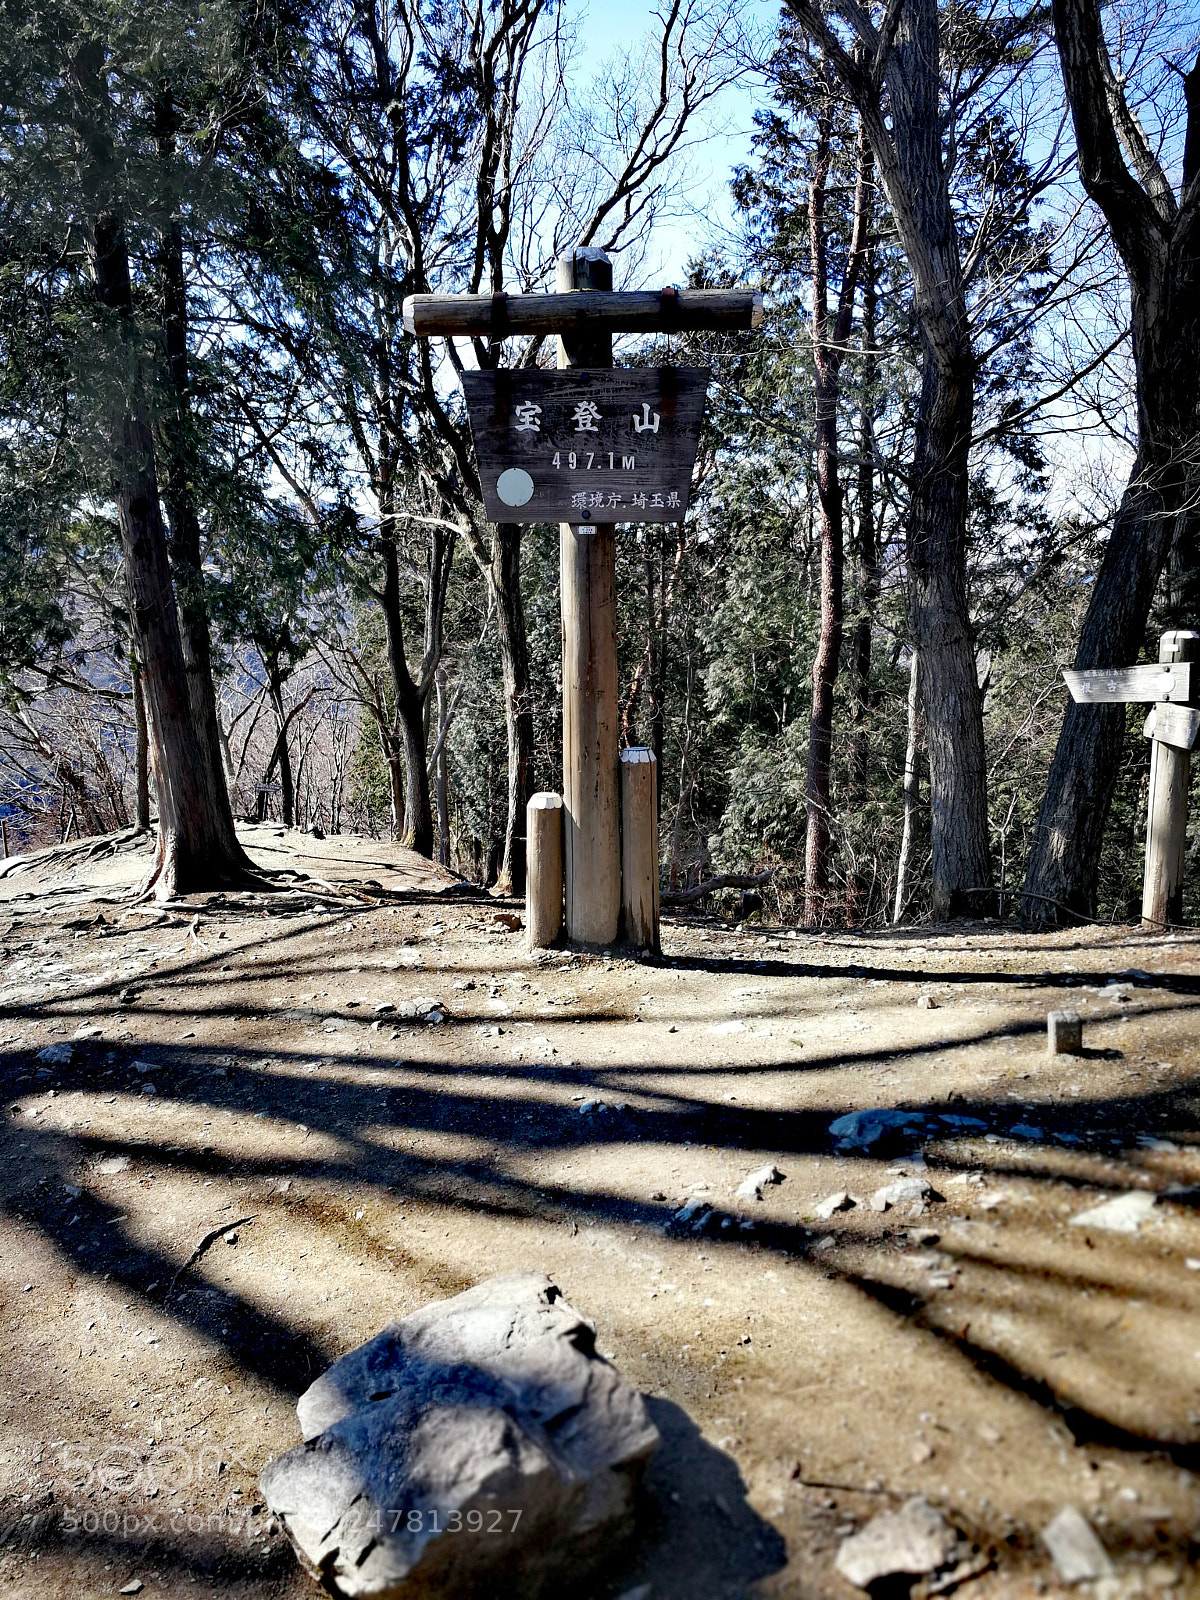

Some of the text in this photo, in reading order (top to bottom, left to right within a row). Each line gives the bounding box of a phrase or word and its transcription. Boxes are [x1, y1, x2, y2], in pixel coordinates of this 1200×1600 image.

[514, 400, 661, 434] 宝登山
[551, 451, 636, 471] 497.1M
